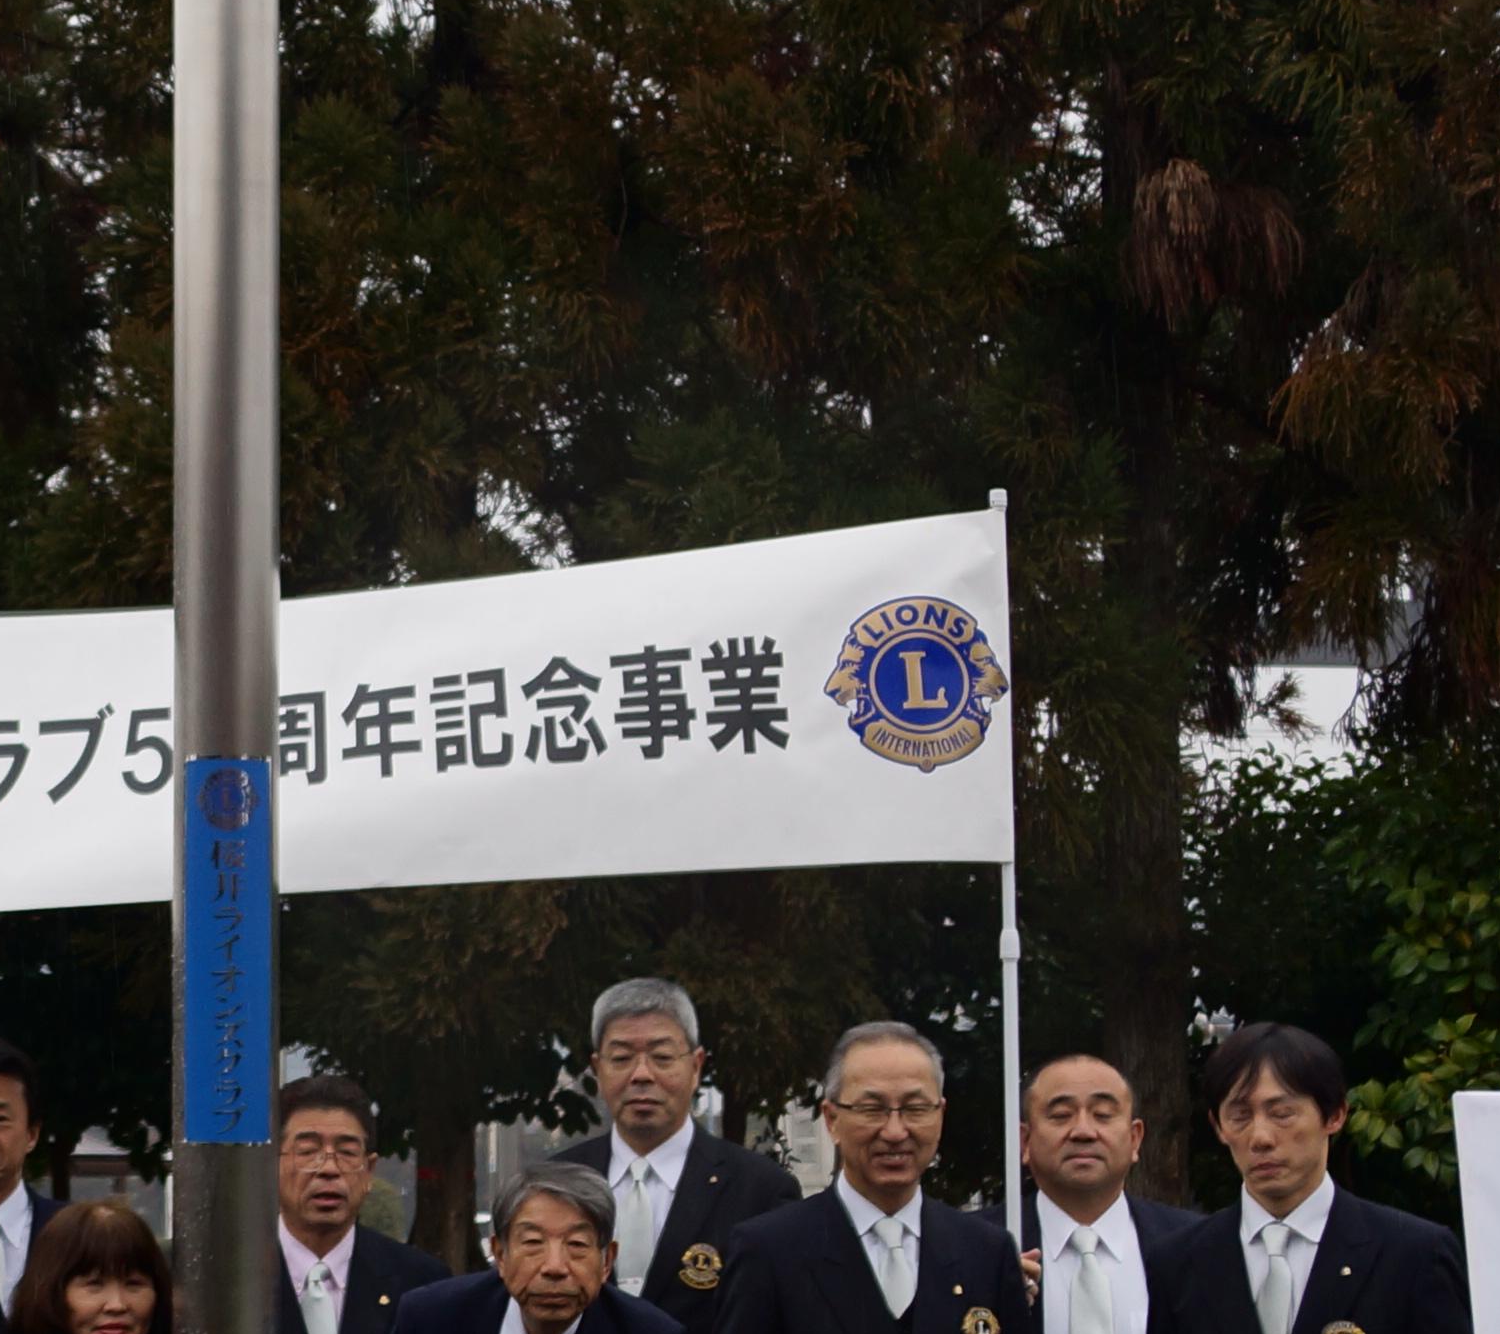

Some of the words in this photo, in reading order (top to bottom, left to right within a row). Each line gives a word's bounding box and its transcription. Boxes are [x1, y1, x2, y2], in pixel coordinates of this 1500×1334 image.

[861, 603, 969, 642] LIONS
[898, 650, 949, 710] L
[871, 726, 975, 758] INTERNATIONAL
[209, 839, 249, 1135] 桜井ライオンズクラブ
